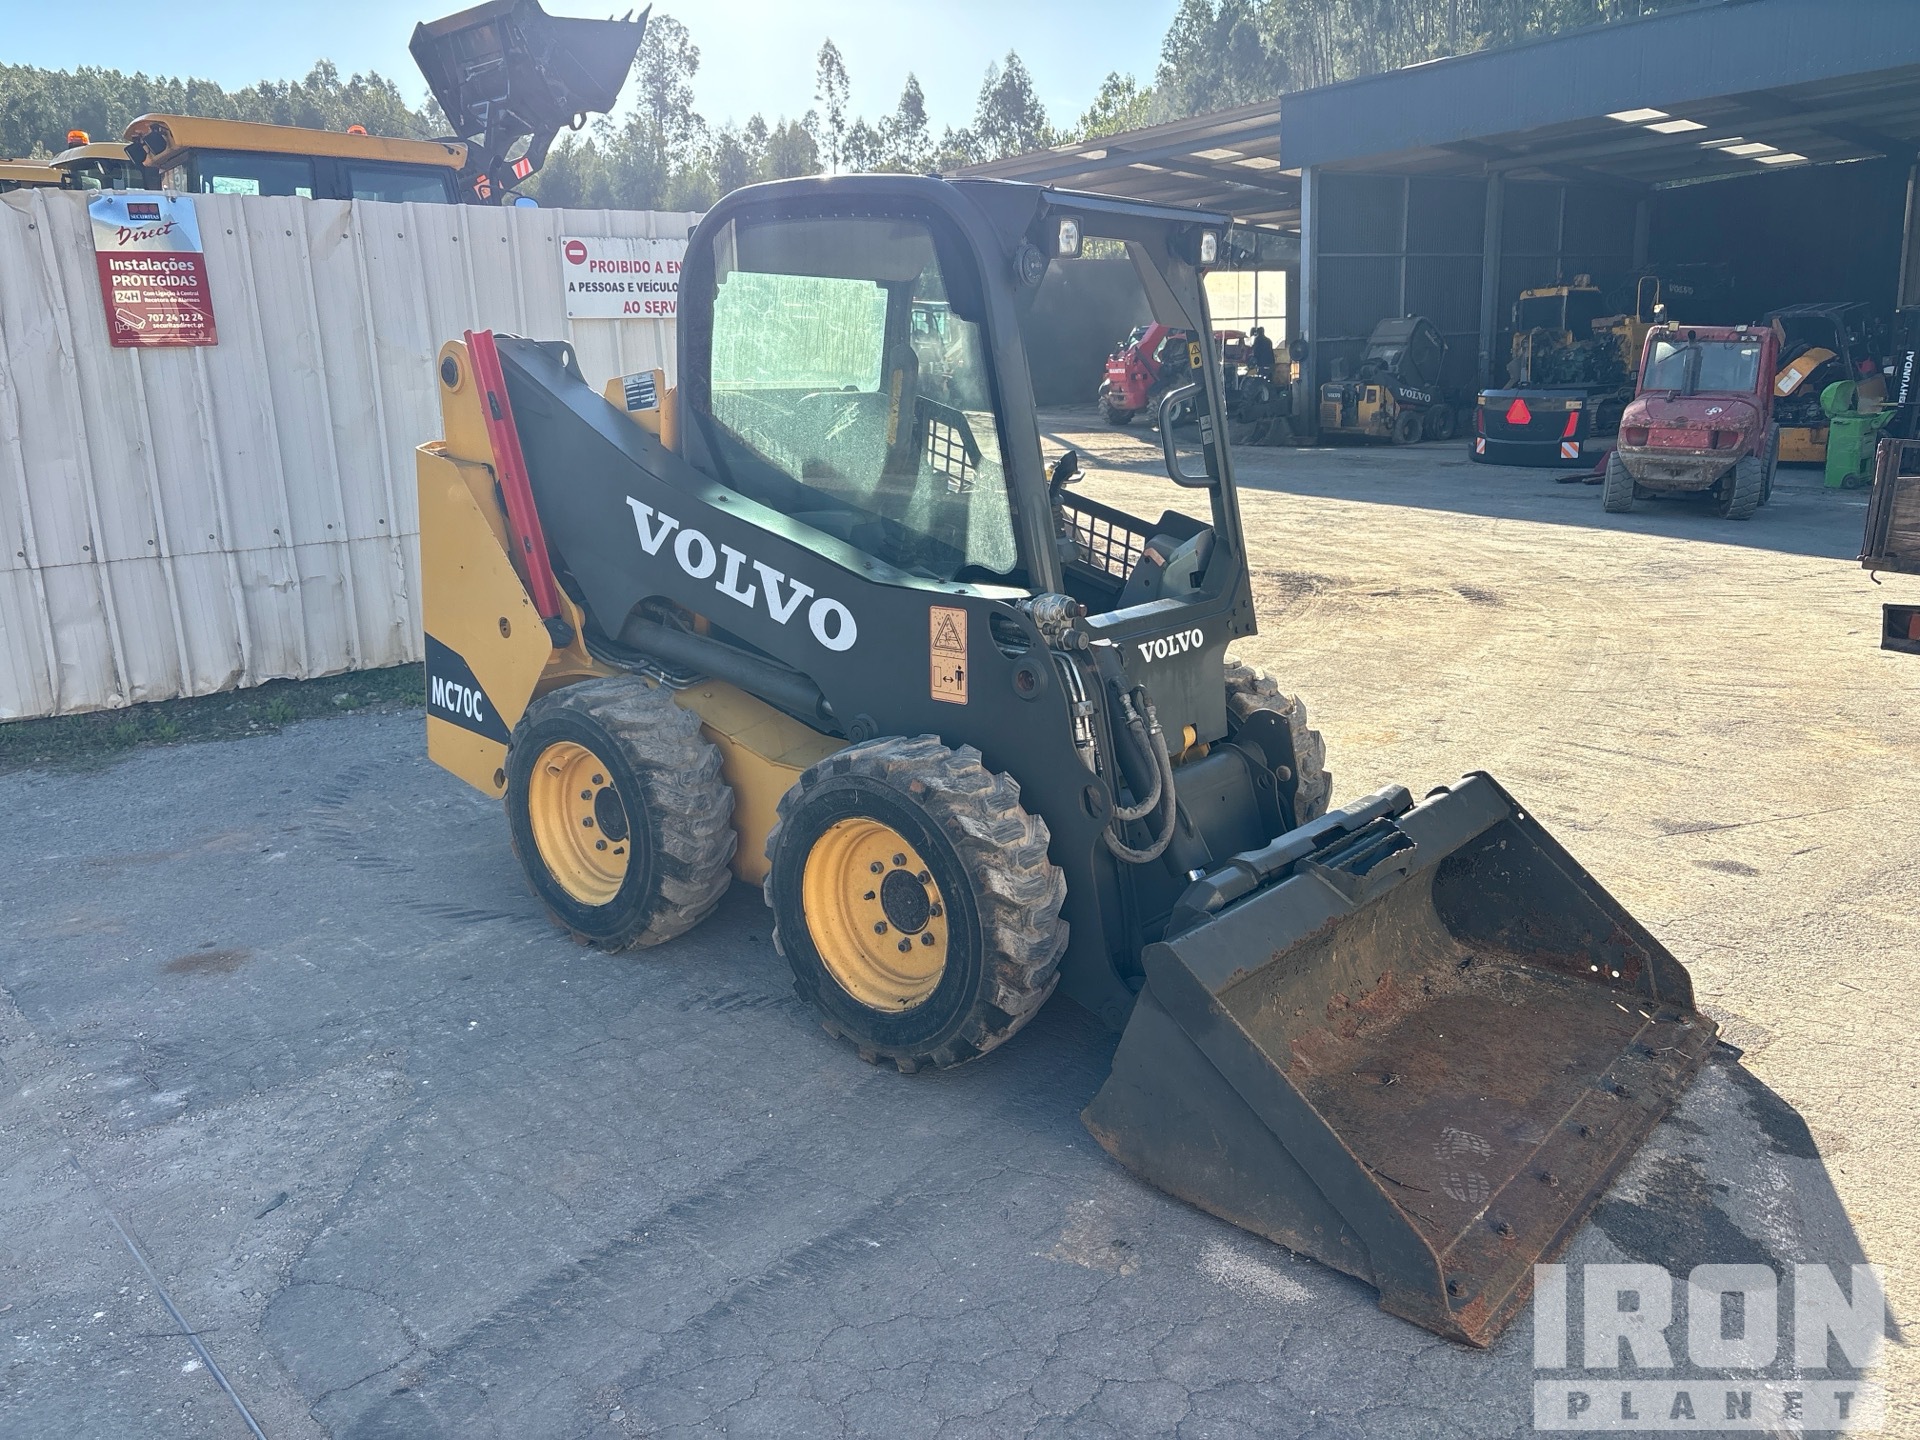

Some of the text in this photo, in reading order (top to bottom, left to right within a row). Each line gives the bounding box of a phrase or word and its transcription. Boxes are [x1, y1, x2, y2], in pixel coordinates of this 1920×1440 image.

[115, 221, 180, 247] Direct
[109, 258, 195, 274] Instalações
[589, 259, 651, 274] PROIBIDO
[654, 260, 663, 274] A
[112, 274, 198, 287] PROTEGIDAS
[568, 281, 576, 293] A
[578, 281, 625, 293] PESSOAS
[627, 282, 634, 293] E
[116, 291, 140, 302] 24H
[623, 300, 640, 314] AO
[147, 313, 204, 322] 707 24 12 24
[1900, 351, 1915, 396] HYUNDAI
[1399, 387, 1431, 403] VOLVO
[625, 495, 858, 652] VOLVO
[1137, 628, 1204, 663] VOLVO
[431, 675, 483, 722] MC70C
